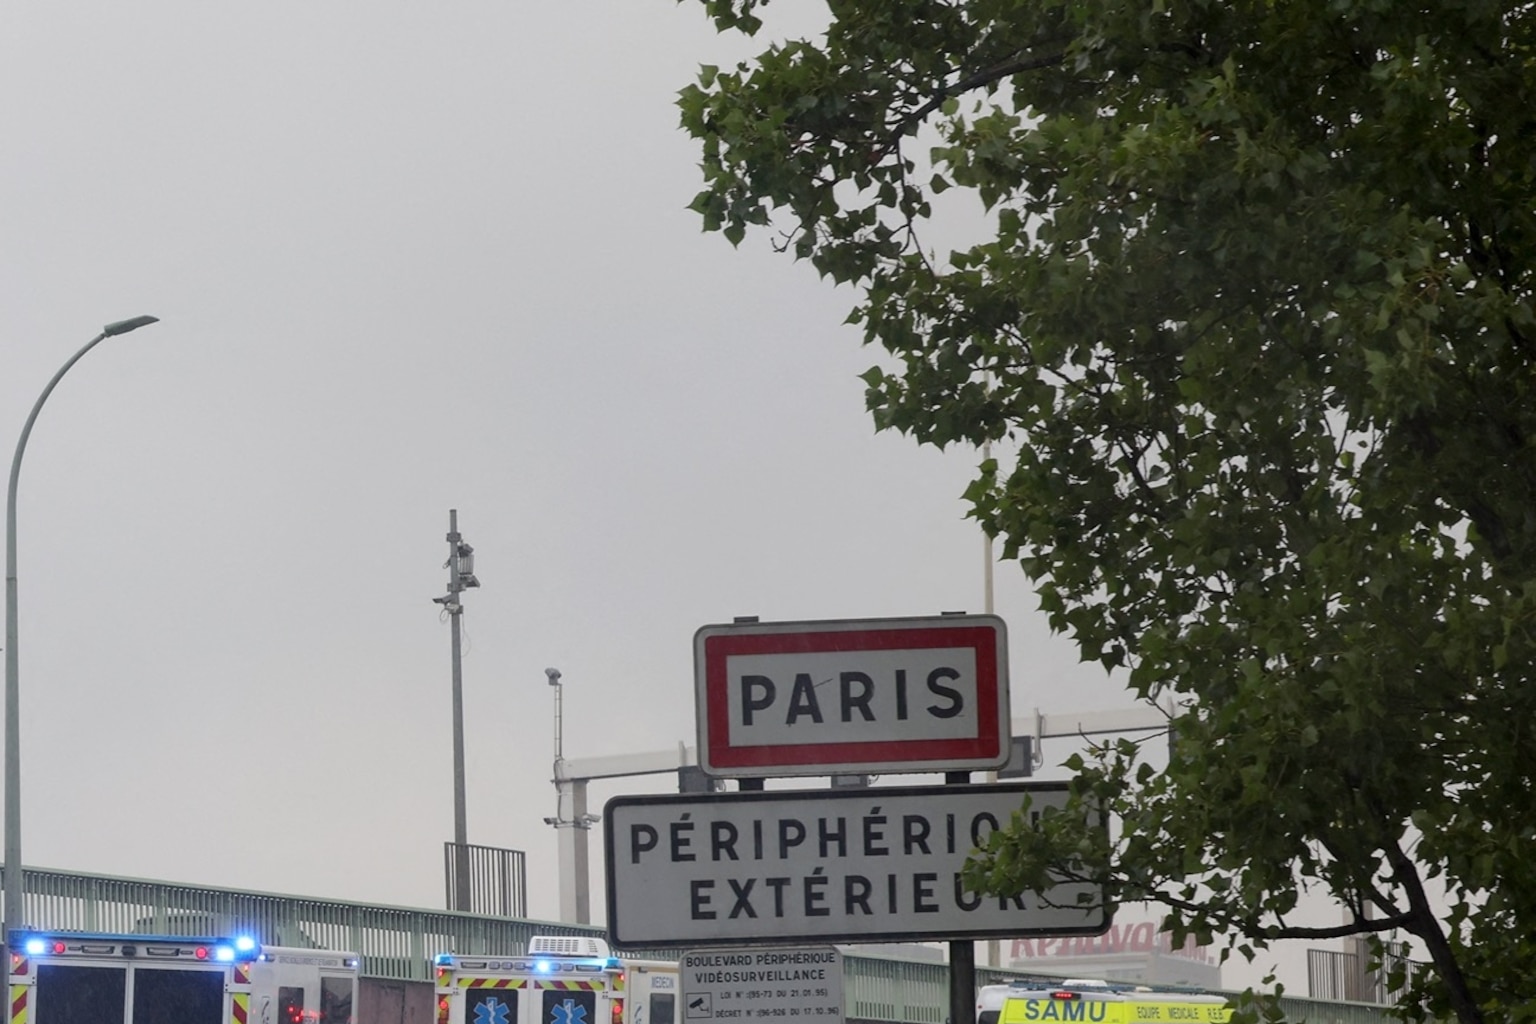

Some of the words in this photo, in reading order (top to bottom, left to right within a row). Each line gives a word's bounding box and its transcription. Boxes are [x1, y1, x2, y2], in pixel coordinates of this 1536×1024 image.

[740, 666, 965, 727] PARIS
[686, 955, 752, 967] BOULEVARD
[756, 952, 836, 966] PÉRIPHÉRIQUE
[695, 970, 825, 983] VIDÉOSURVEILLANCE
[720, 991, 732, 999] LOI
[776, 990, 787, 998] DU
[715, 1008, 742, 1018] DÉCRET
[790, 1008, 800, 1016] DU
[1025, 999, 1107, 1022] SAMU
[1137, 1006, 1161, 1019] EQUIPE
[1167, 1007, 1200, 1020] MEDICALE
